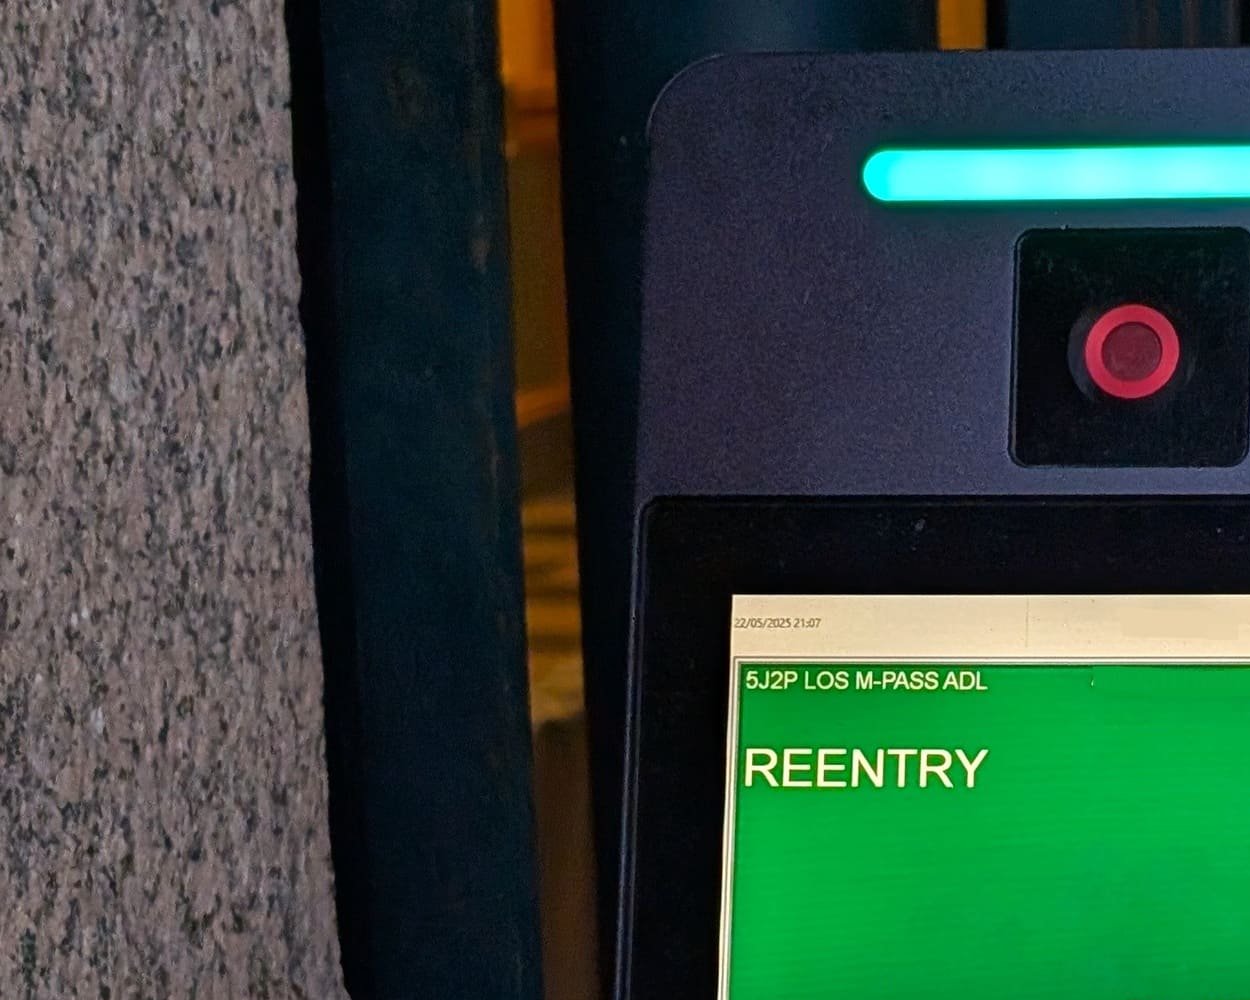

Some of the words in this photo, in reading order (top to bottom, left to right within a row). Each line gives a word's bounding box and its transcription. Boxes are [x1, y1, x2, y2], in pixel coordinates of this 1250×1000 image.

[734, 617, 792, 629] 22/05/2025
[793, 618, 821, 629] 21:07
[745, 671, 798, 690] 5J2P
[804, 671, 849, 690] LOS
[855, 671, 939, 690] M-PASS
[942, 671, 988, 690] ADL
[744, 748, 989, 788] REENTRY
